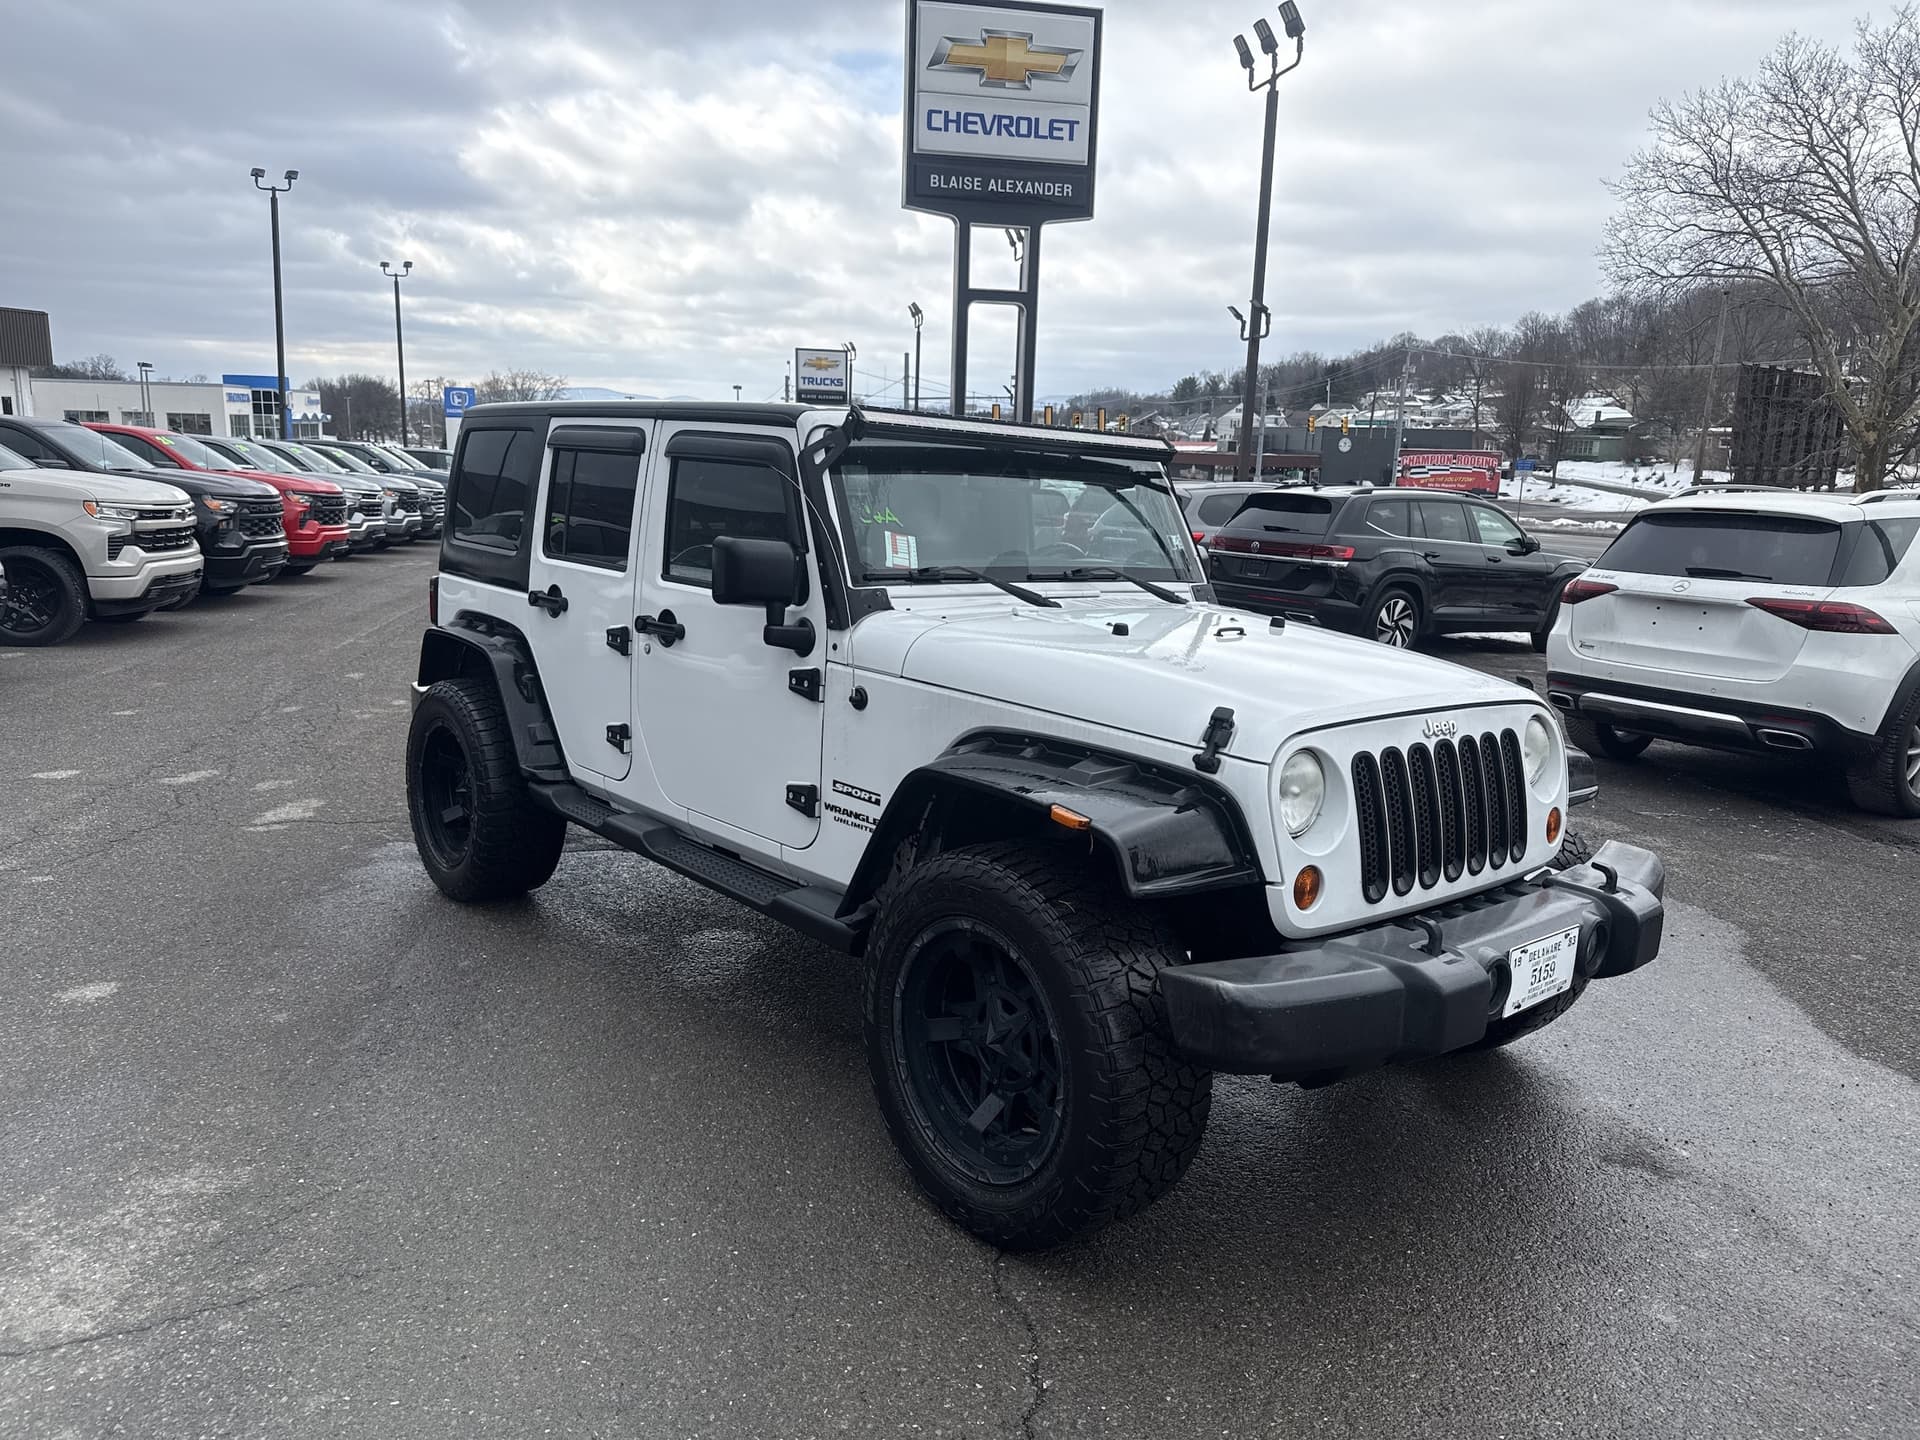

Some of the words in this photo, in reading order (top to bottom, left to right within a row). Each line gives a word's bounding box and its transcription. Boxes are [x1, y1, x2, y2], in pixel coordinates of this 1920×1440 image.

[927, 109, 1080, 142] CHEVROLET
[930, 174, 982, 191] BLAISE
[988, 178, 1072, 197] ALEXANDER
[801, 376, 843, 386] TRUCKS
[1401, 454, 1453, 466] CHAMPION
[1456, 455, 1498, 467] ROOFING
[1423, 718, 1457, 738] Jeep
[834, 783, 878, 802] SPORT
[824, 802, 880, 825] WRANGLE
[834, 816, 875, 833] UNLIMITE
[1529, 941, 1562, 962] DELAWARE
[1530, 961, 1556, 985] 5159
